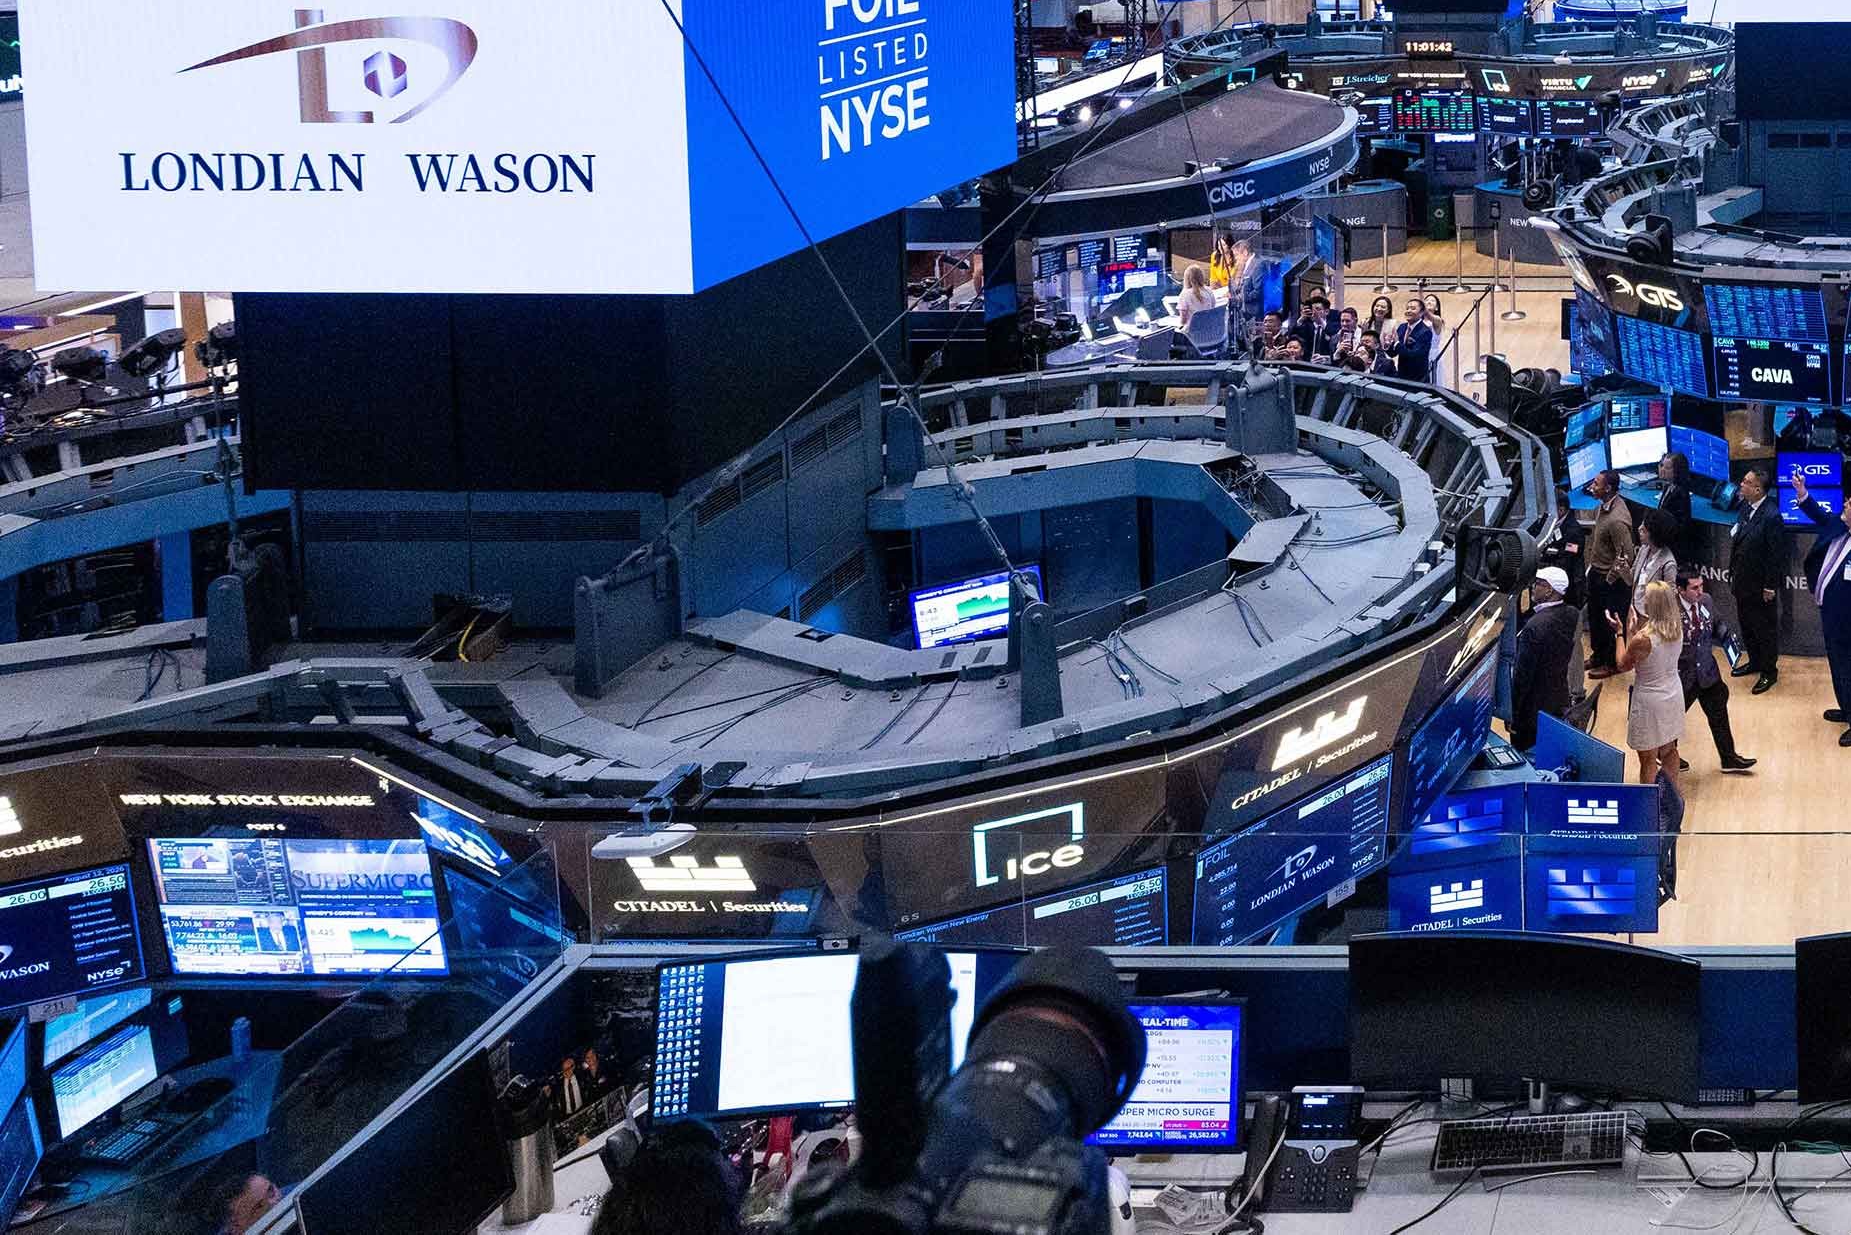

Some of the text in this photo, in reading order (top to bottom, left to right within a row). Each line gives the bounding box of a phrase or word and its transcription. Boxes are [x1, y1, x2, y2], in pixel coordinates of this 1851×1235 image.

[818, 32, 928, 85] LISTED
[1541, 78, 1573, 86] VIRTU
[820, 76, 930, 161] NYSE
[119, 152, 596, 193] LONDIAN WASON
[1209, 179, 1255, 204] CNBC
[1510, 218, 1528, 227] NEW
[1636, 283, 1684, 311] GTS
[1717, 338, 1735, 346] CAVA
[1751, 367, 1793, 384] CAVA
[1804, 464, 1830, 475] GTS
[1231, 731, 1378, 810] CITADEL Securities
[120, 794, 375, 807] NEW YORK STOCK EXCHANGE
[0, 834, 83, 858] curities
[1205, 849, 1231, 867] FOIL
[89, 874, 125, 889] 26.50
[1132, 878, 1162, 893] 26.50
[1250, 856, 1335, 910] LONDIAN WASON
[9, 891, 46, 905] 26.00
[1068, 894, 1098, 909] 26.00
[1221, 900, 1236, 911] 0.00
[613, 900, 808, 913] CITADEL Securities
[1220, 918, 1235, 929] 0.00
[1411, 912, 1502, 931] CITADEL Securities
[1219, 935, 1234, 946] 0.00
[1139, 1017, 1188, 1027] EAL-TIME
[1148, 1108, 1216, 1116] MICRO SURGE
